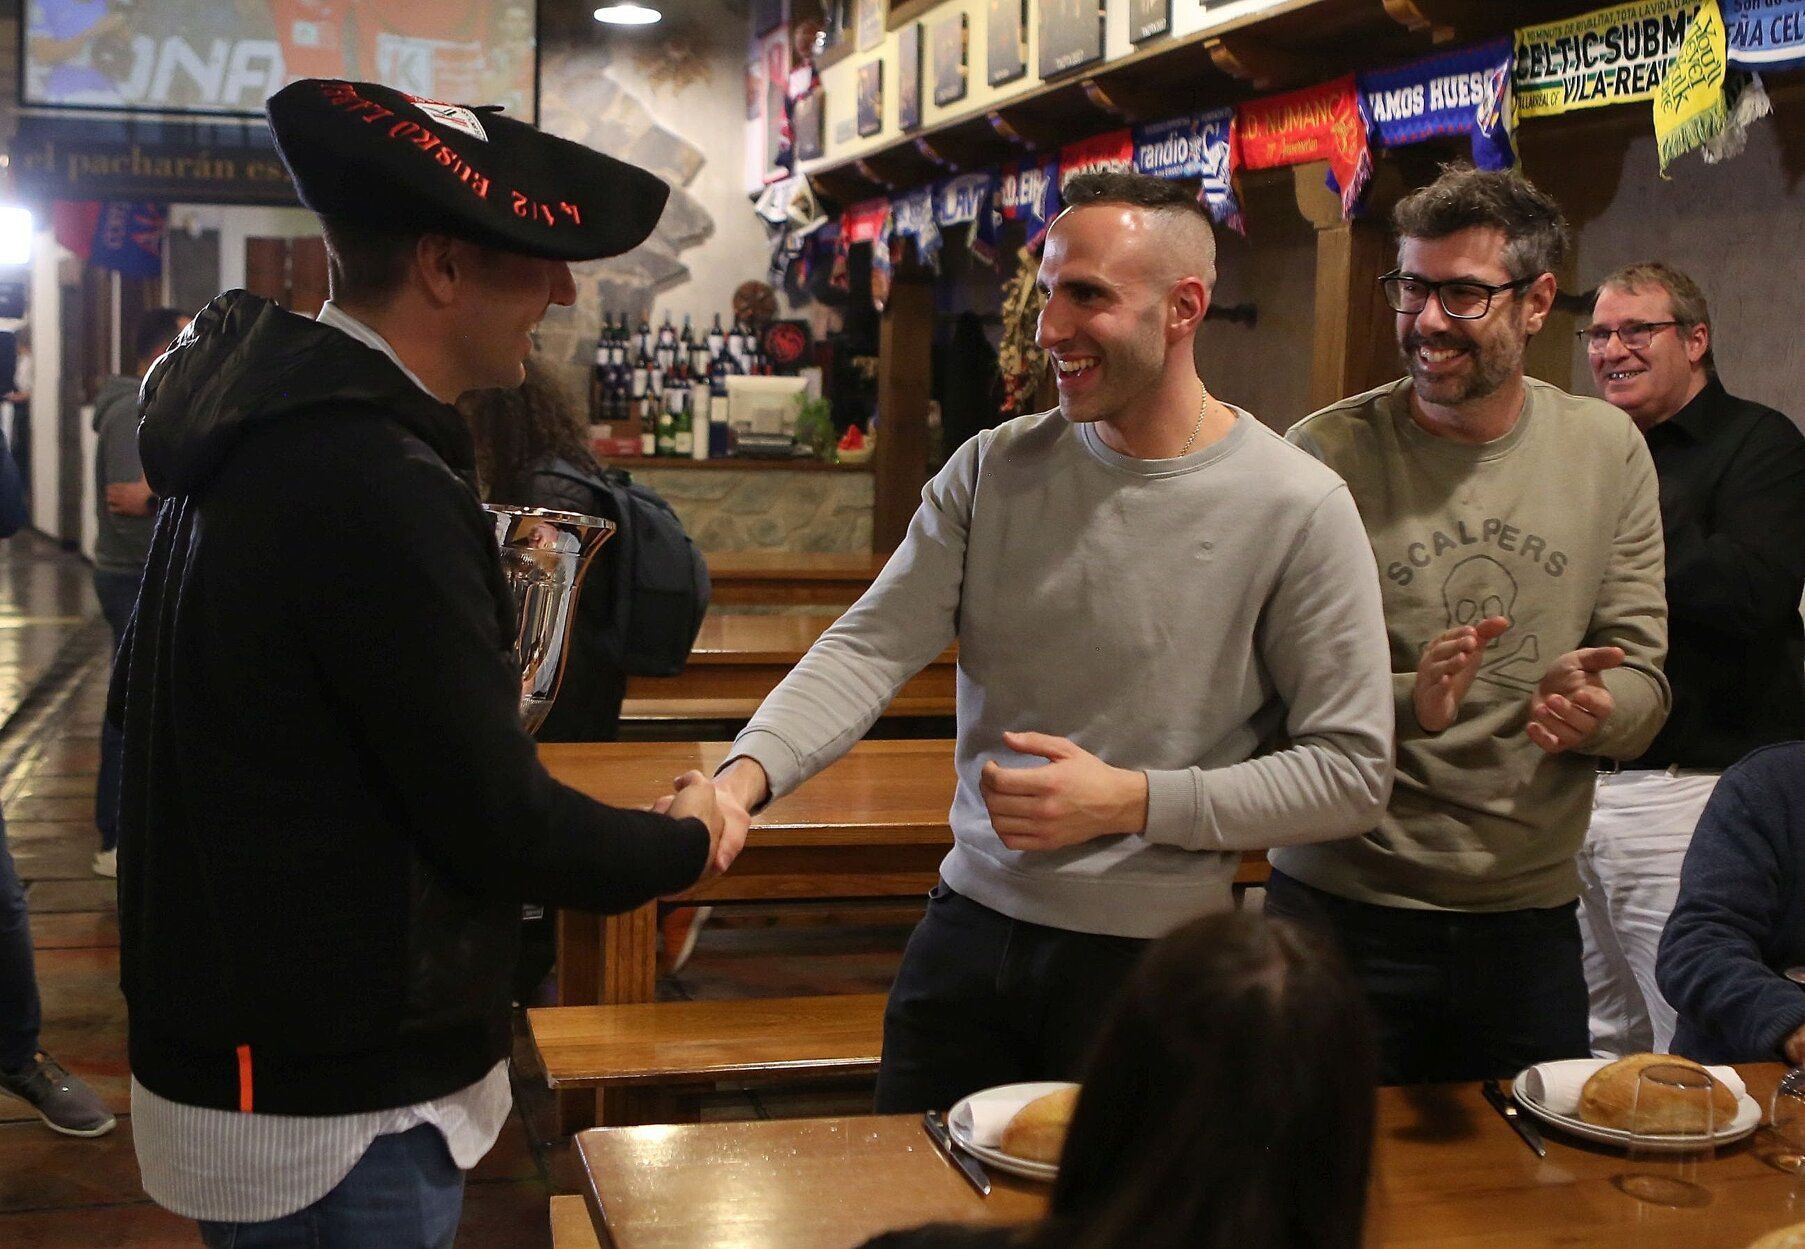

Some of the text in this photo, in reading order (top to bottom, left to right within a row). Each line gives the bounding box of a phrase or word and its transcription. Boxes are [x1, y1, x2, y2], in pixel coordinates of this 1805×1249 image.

[1516, 5, 1701, 80] CELTIC SUBM
[1770, 10, 1805, 44] CEL
[1387, 518, 1568, 586] SCALPERS
